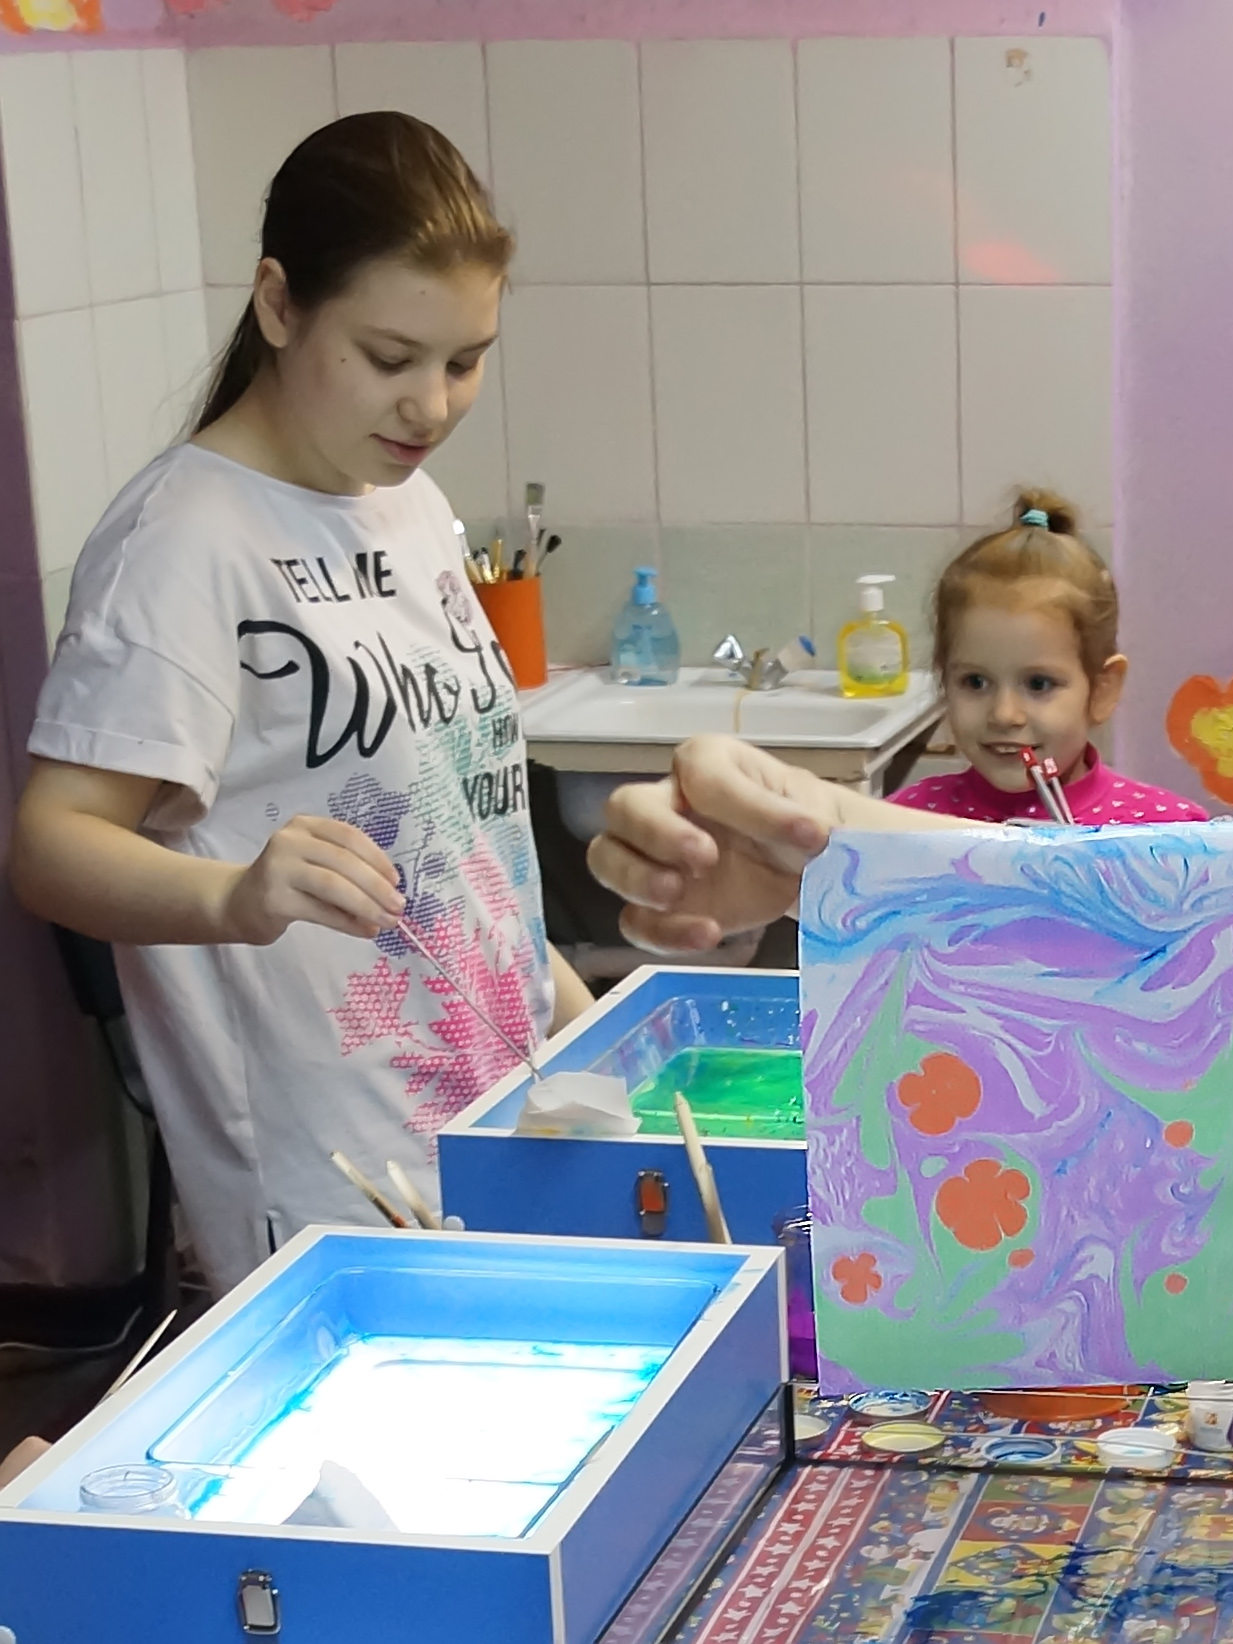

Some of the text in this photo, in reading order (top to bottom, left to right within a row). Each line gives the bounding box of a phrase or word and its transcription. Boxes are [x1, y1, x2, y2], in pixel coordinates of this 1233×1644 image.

[269, 550, 397, 603] TELL ME
[461, 763, 527, 822] YOUR
